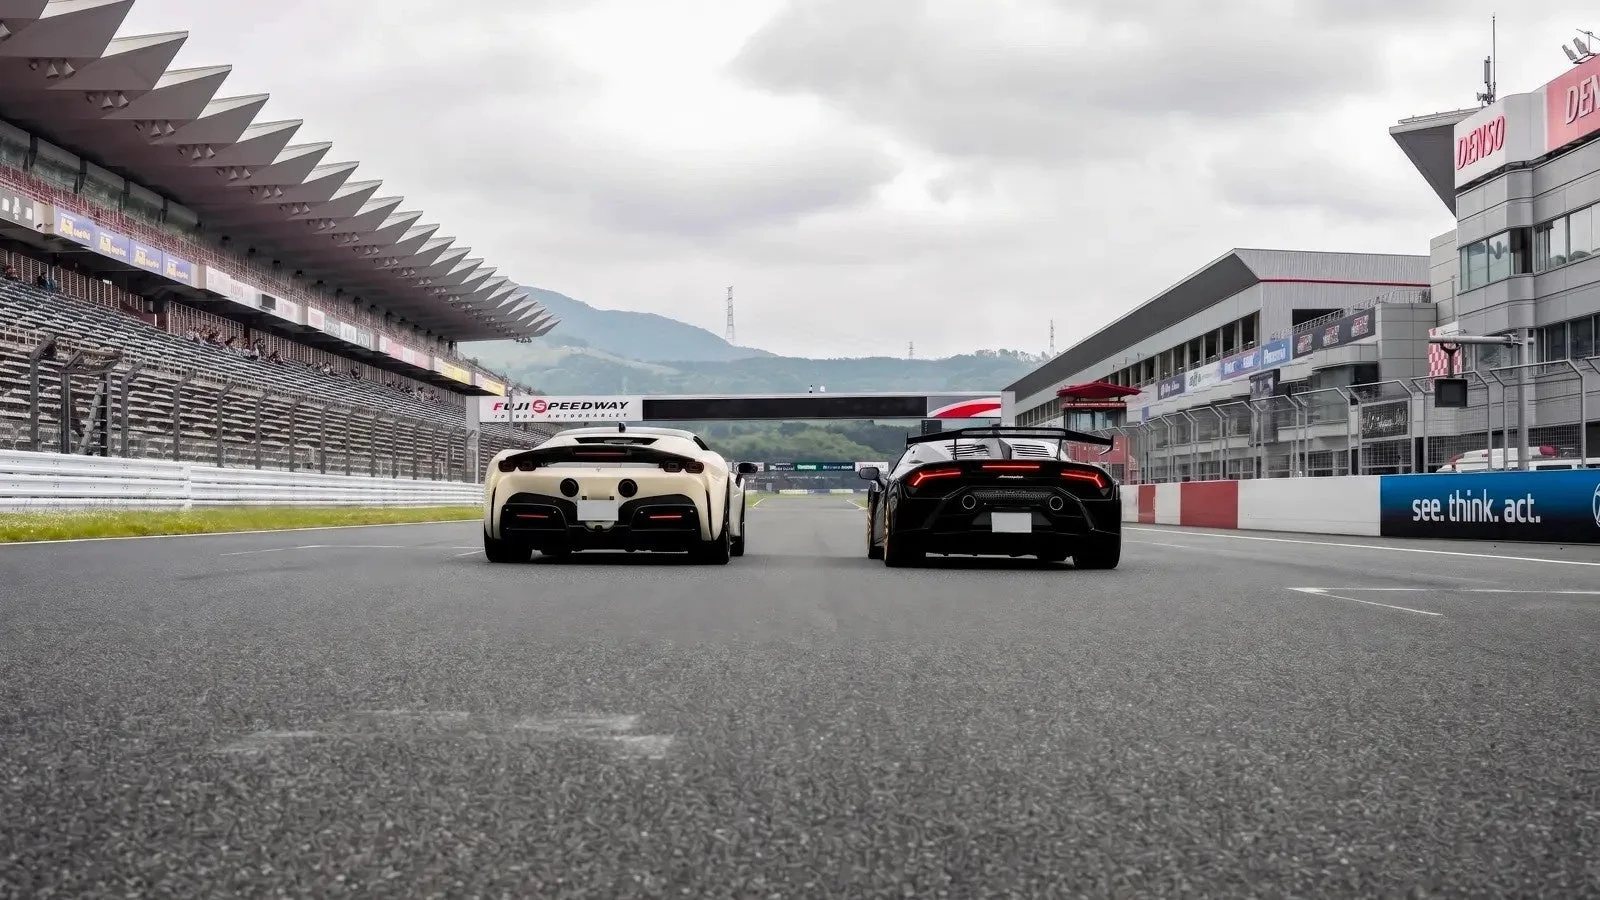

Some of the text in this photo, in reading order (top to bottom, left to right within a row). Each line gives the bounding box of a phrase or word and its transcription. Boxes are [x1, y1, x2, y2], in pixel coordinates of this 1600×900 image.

[1456, 114, 1505, 170] DENSO
[493, 400, 629, 413] FUJI SPEEDWAY
[1412, 488, 1541, 523] see. think. act.
